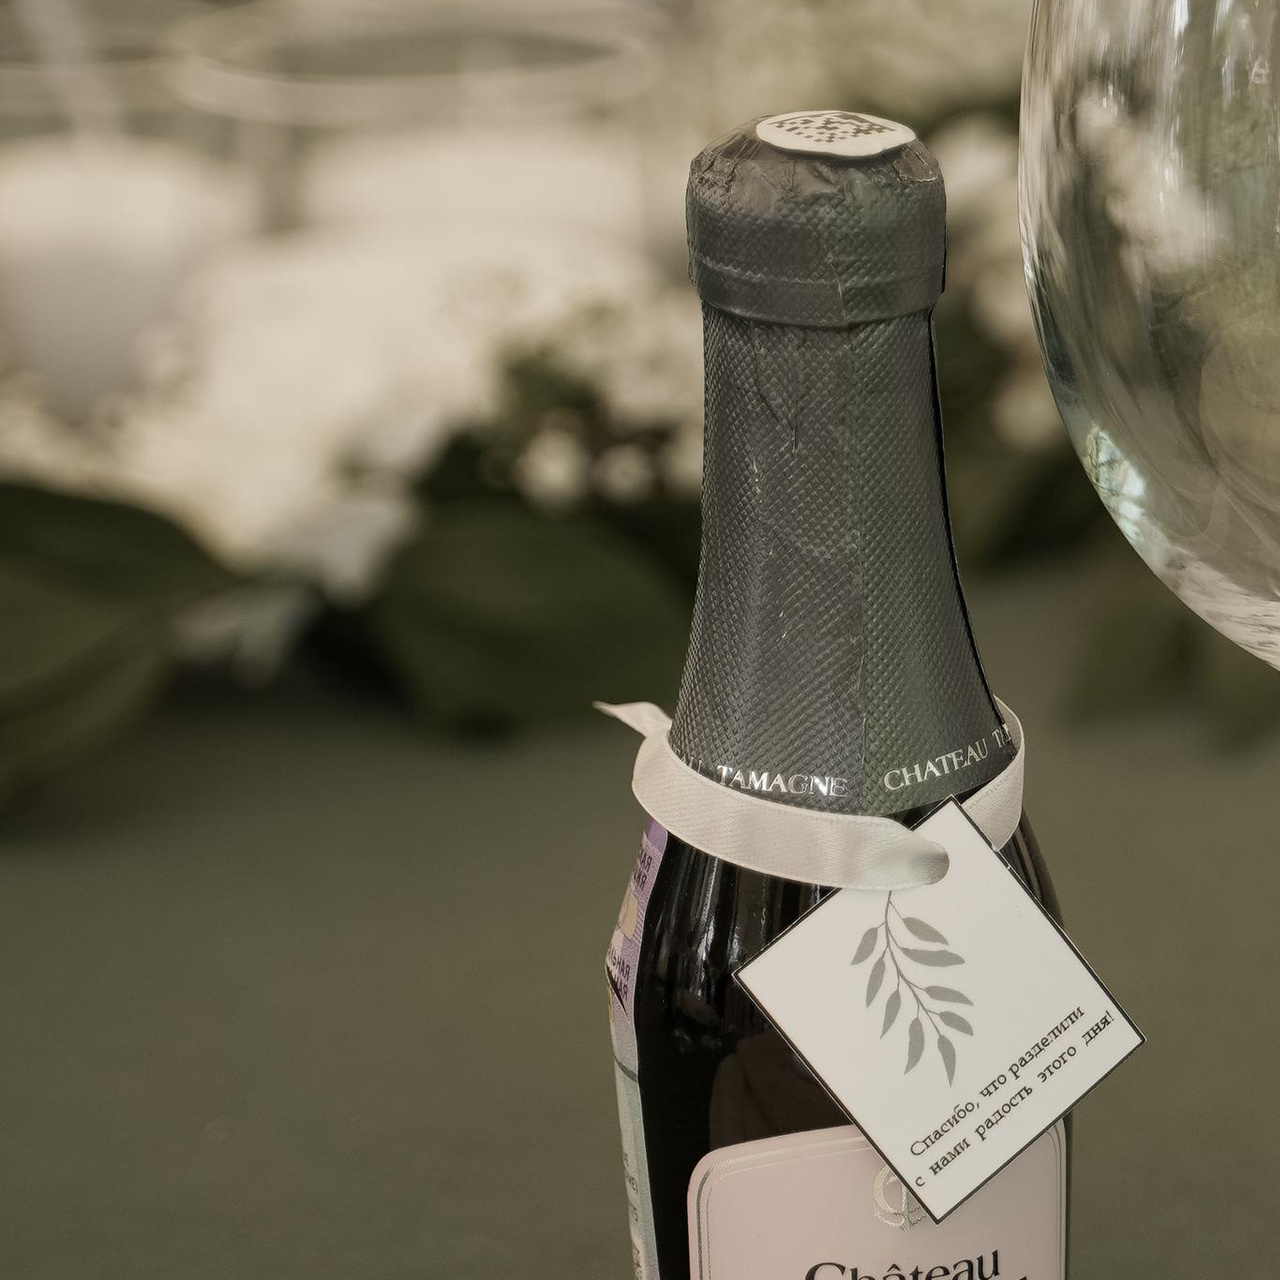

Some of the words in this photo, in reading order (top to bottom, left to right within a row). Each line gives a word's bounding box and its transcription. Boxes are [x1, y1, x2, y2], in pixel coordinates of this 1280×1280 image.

[716, 765, 848, 798] TAMAGNE
[883, 738, 988, 792] CHATEAU
[910, 1102, 980, 1156] Спасибо,
[979, 1074, 1007, 1099] что
[1008, 1006, 1085, 1080] разделили
[914, 1176, 926, 1187] с
[929, 1138, 971, 1175] нами
[974, 1086, 1033, 1141] радость
[1037, 1046, 1077, 1083] этого
[1081, 1010, 1115, 1046] дня!
